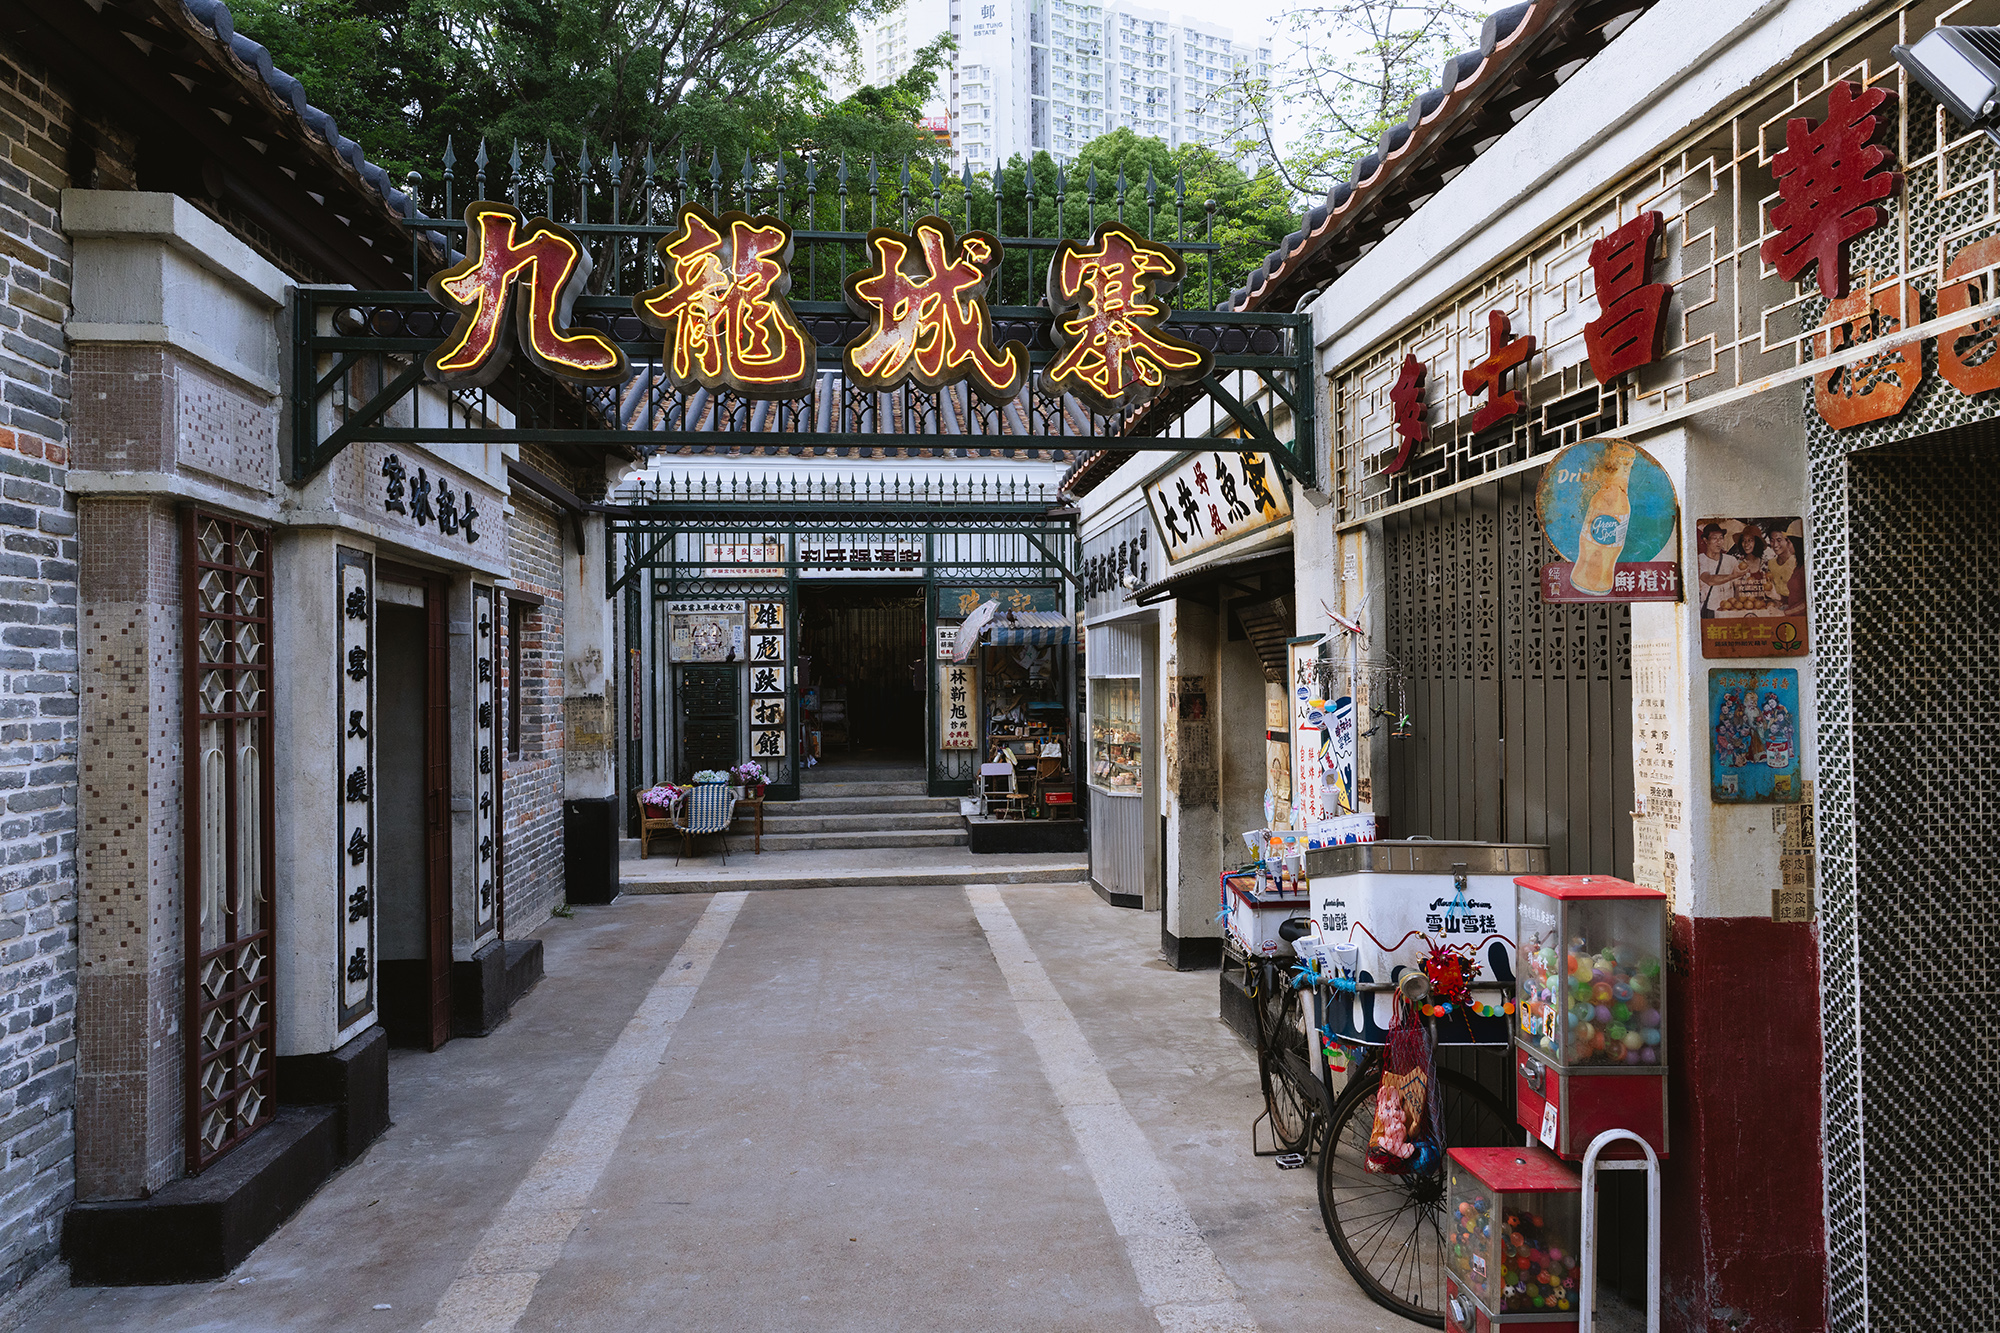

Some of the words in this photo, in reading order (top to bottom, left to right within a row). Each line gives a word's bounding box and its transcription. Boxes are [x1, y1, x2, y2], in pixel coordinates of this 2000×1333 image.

[973, 29, 996, 37] ESTATE
[986, 21, 1003, 29] TUNG
[432, 208, 1205, 400] 九龍城寨
[1592, 517, 1618, 534] Green
[1597, 528, 1617, 542] Spot
[1614, 570, 1678, 593] 鮮橙汁
[1706, 623, 1772, 640] 新奇士
[949, 668, 968, 719] 林靳旭
[950, 721, 968, 730] 診所
[1801, 805, 1815, 847] 皮膚病
[1793, 892, 1806, 919] 皮癬
[1322, 913, 1349, 932] 雪山雪糕
[1426, 913, 1498, 934] 雪山雪糕
